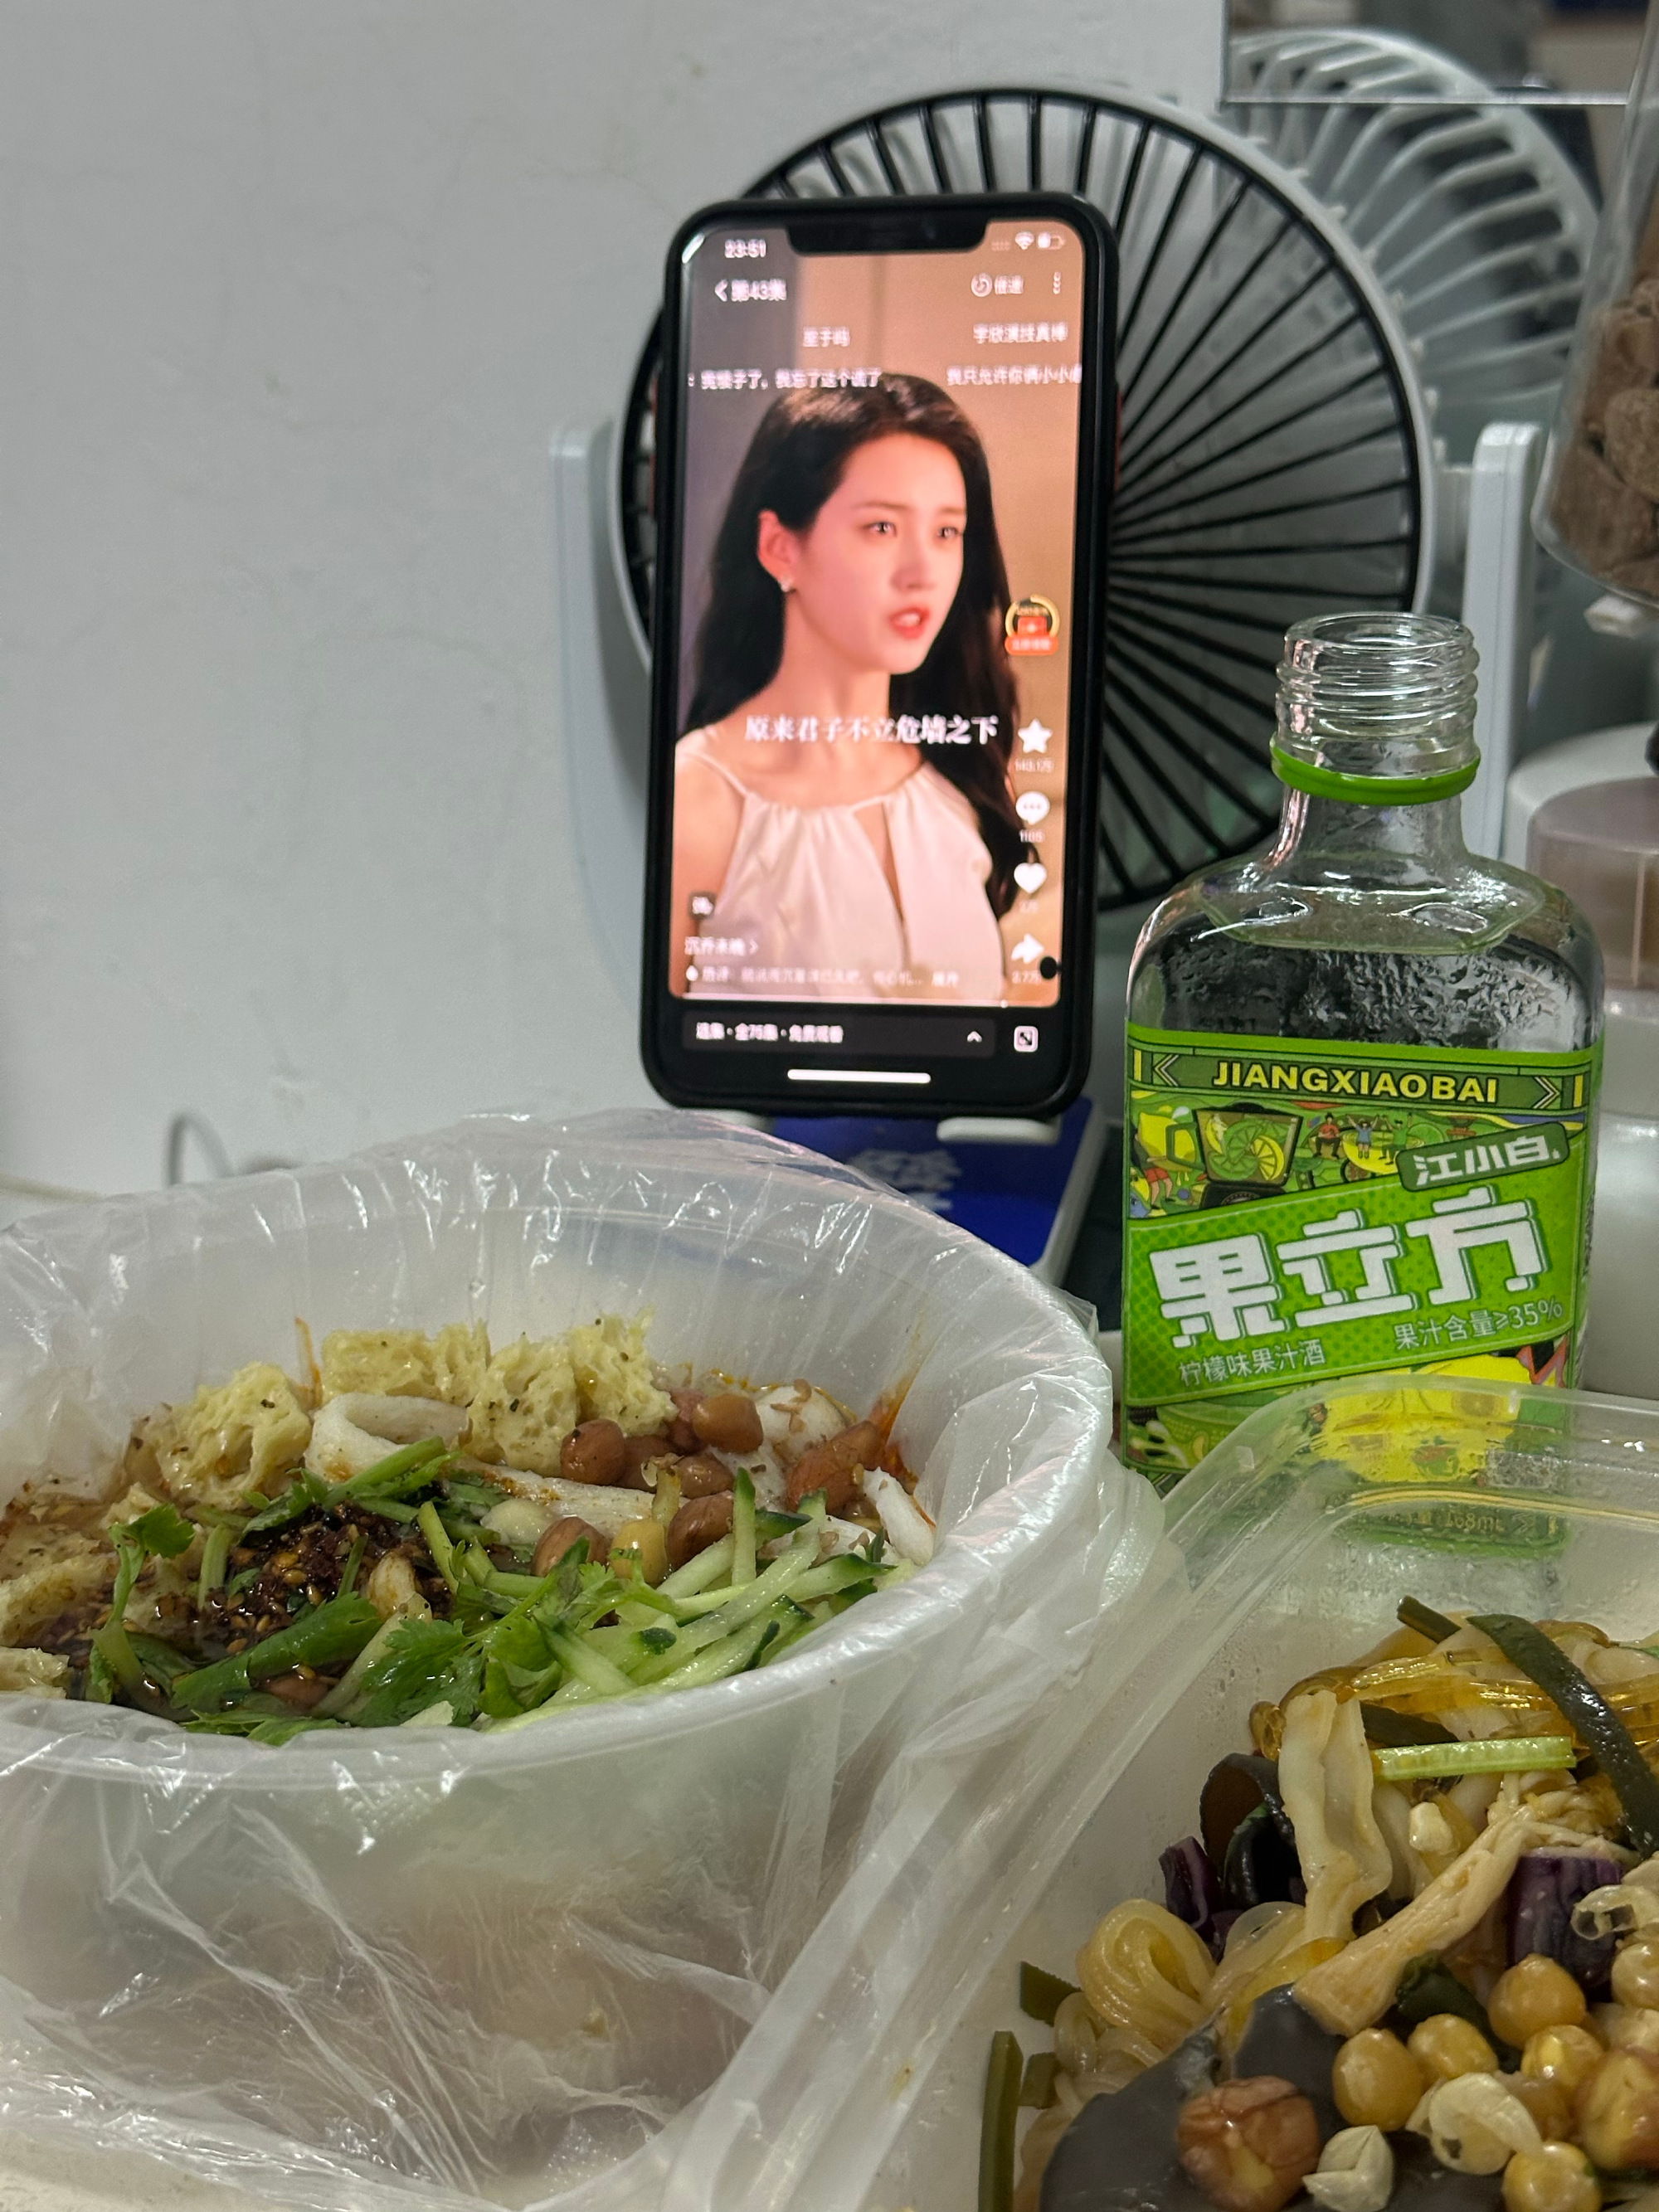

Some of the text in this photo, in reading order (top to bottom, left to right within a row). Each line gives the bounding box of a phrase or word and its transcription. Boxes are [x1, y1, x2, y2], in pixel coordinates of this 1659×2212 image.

[725, 239, 766, 259] 23:51
[731, 279, 786, 302] 第43集
[744, 714, 999, 745] 原来君子不立危墙之下
[1213, 1061, 1498, 1104] JIANGXIAOBAI
[1414, 1134, 1551, 1186] 江小白
[1149, 1186, 1552, 1349] 果立方
[1394, 1296, 1564, 1350] 果汁含量≥35%
[1178, 1339, 1326, 1388] 柠檬味果汁酒
